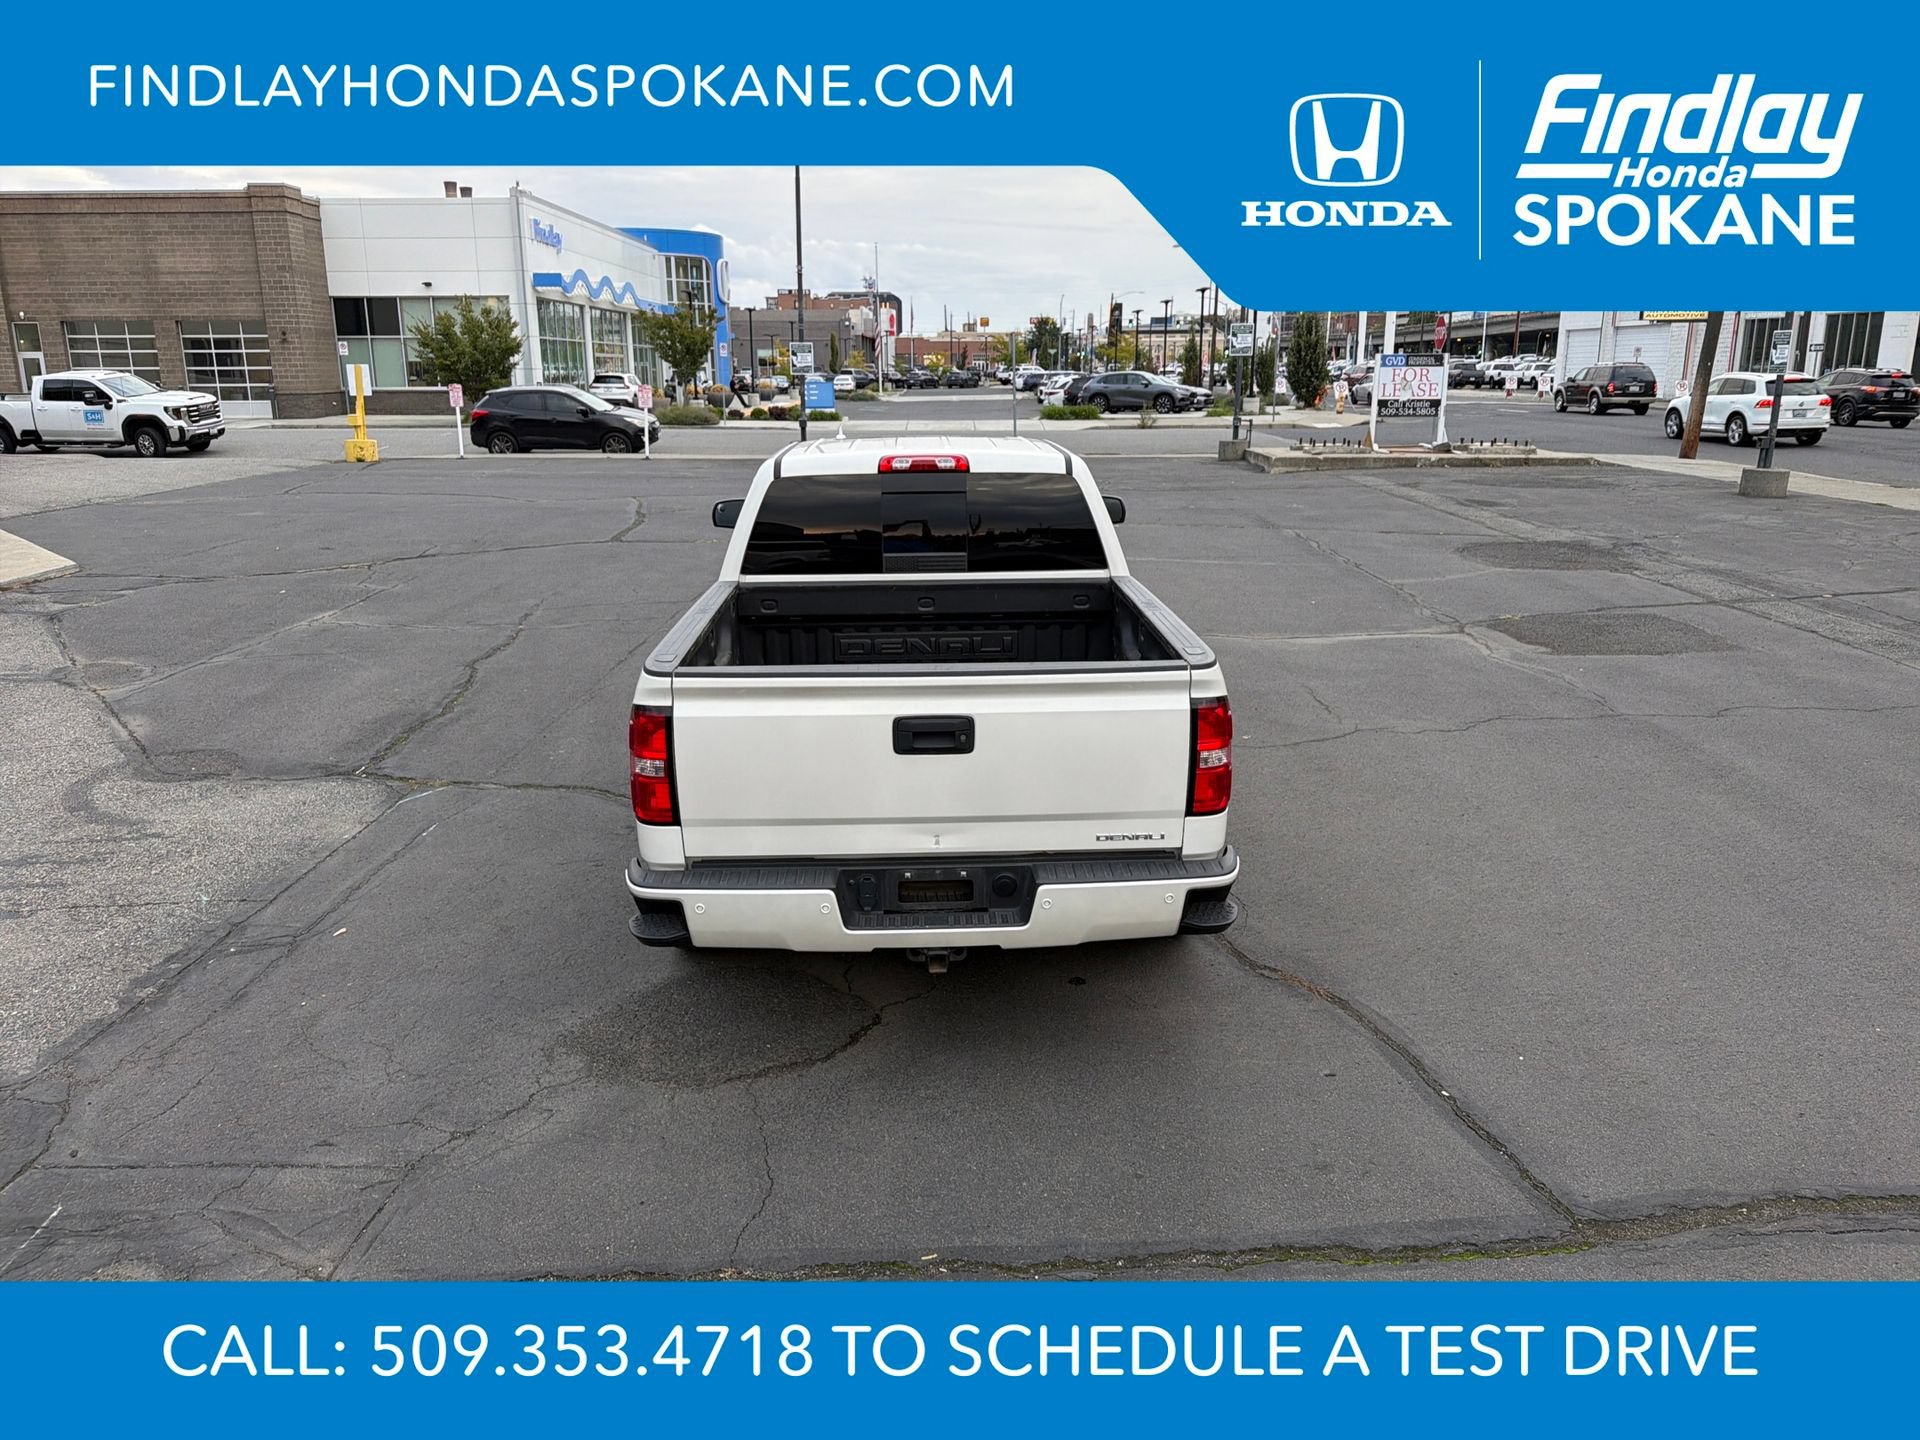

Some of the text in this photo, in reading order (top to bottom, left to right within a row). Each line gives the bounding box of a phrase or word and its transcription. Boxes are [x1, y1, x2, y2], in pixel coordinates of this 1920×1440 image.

[1434, 326, 1447, 340] STOP
[1385, 356, 1406, 366] GVD
[1391, 367, 1431, 383] FOR
[1387, 399, 1404, 408] Call
[1380, 407, 1437, 416] 509-534-5805
[838, 636, 1013, 657] DENALI
[1095, 832, 1166, 842] DENALI
